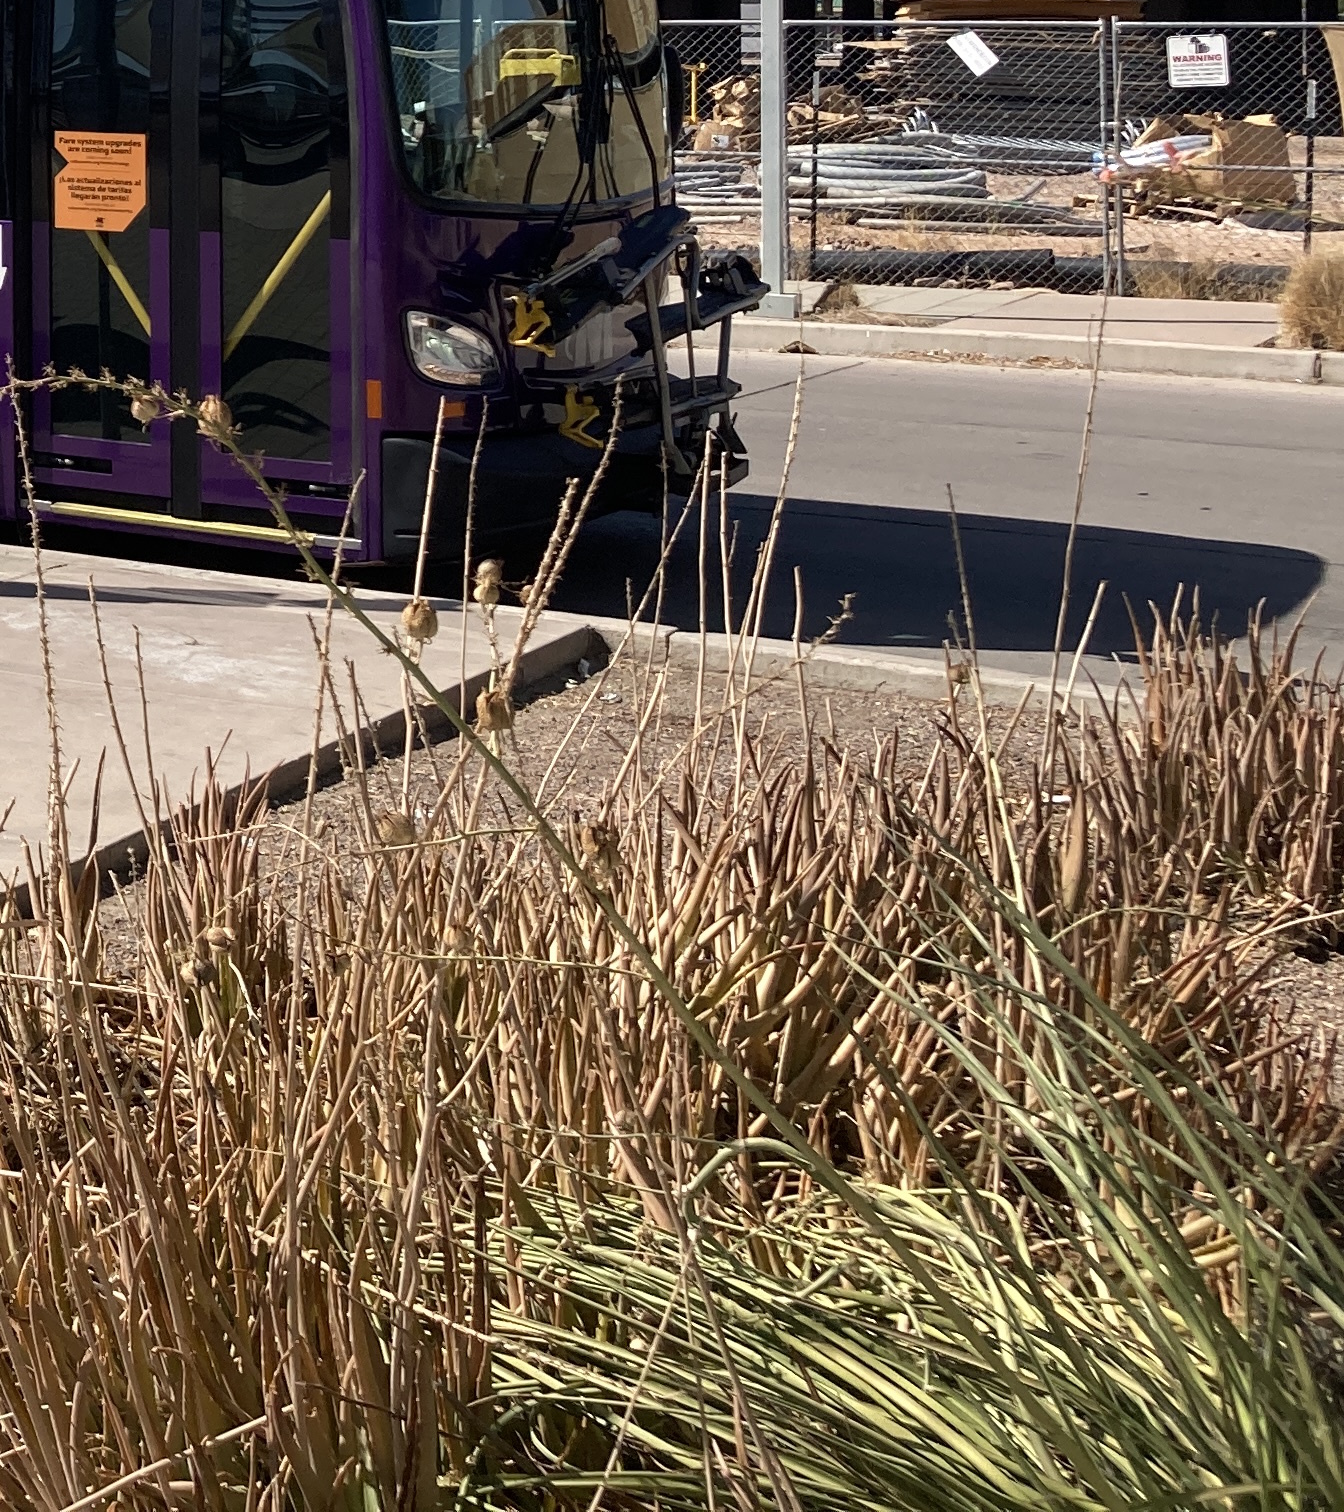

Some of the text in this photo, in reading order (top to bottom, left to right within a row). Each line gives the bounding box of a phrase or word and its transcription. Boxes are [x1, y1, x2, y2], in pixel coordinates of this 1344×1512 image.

[1172, 54, 1223, 63] WARNING
[59, 137, 142, 148] Fare system upgrades
[81, 146, 109, 155] coming
